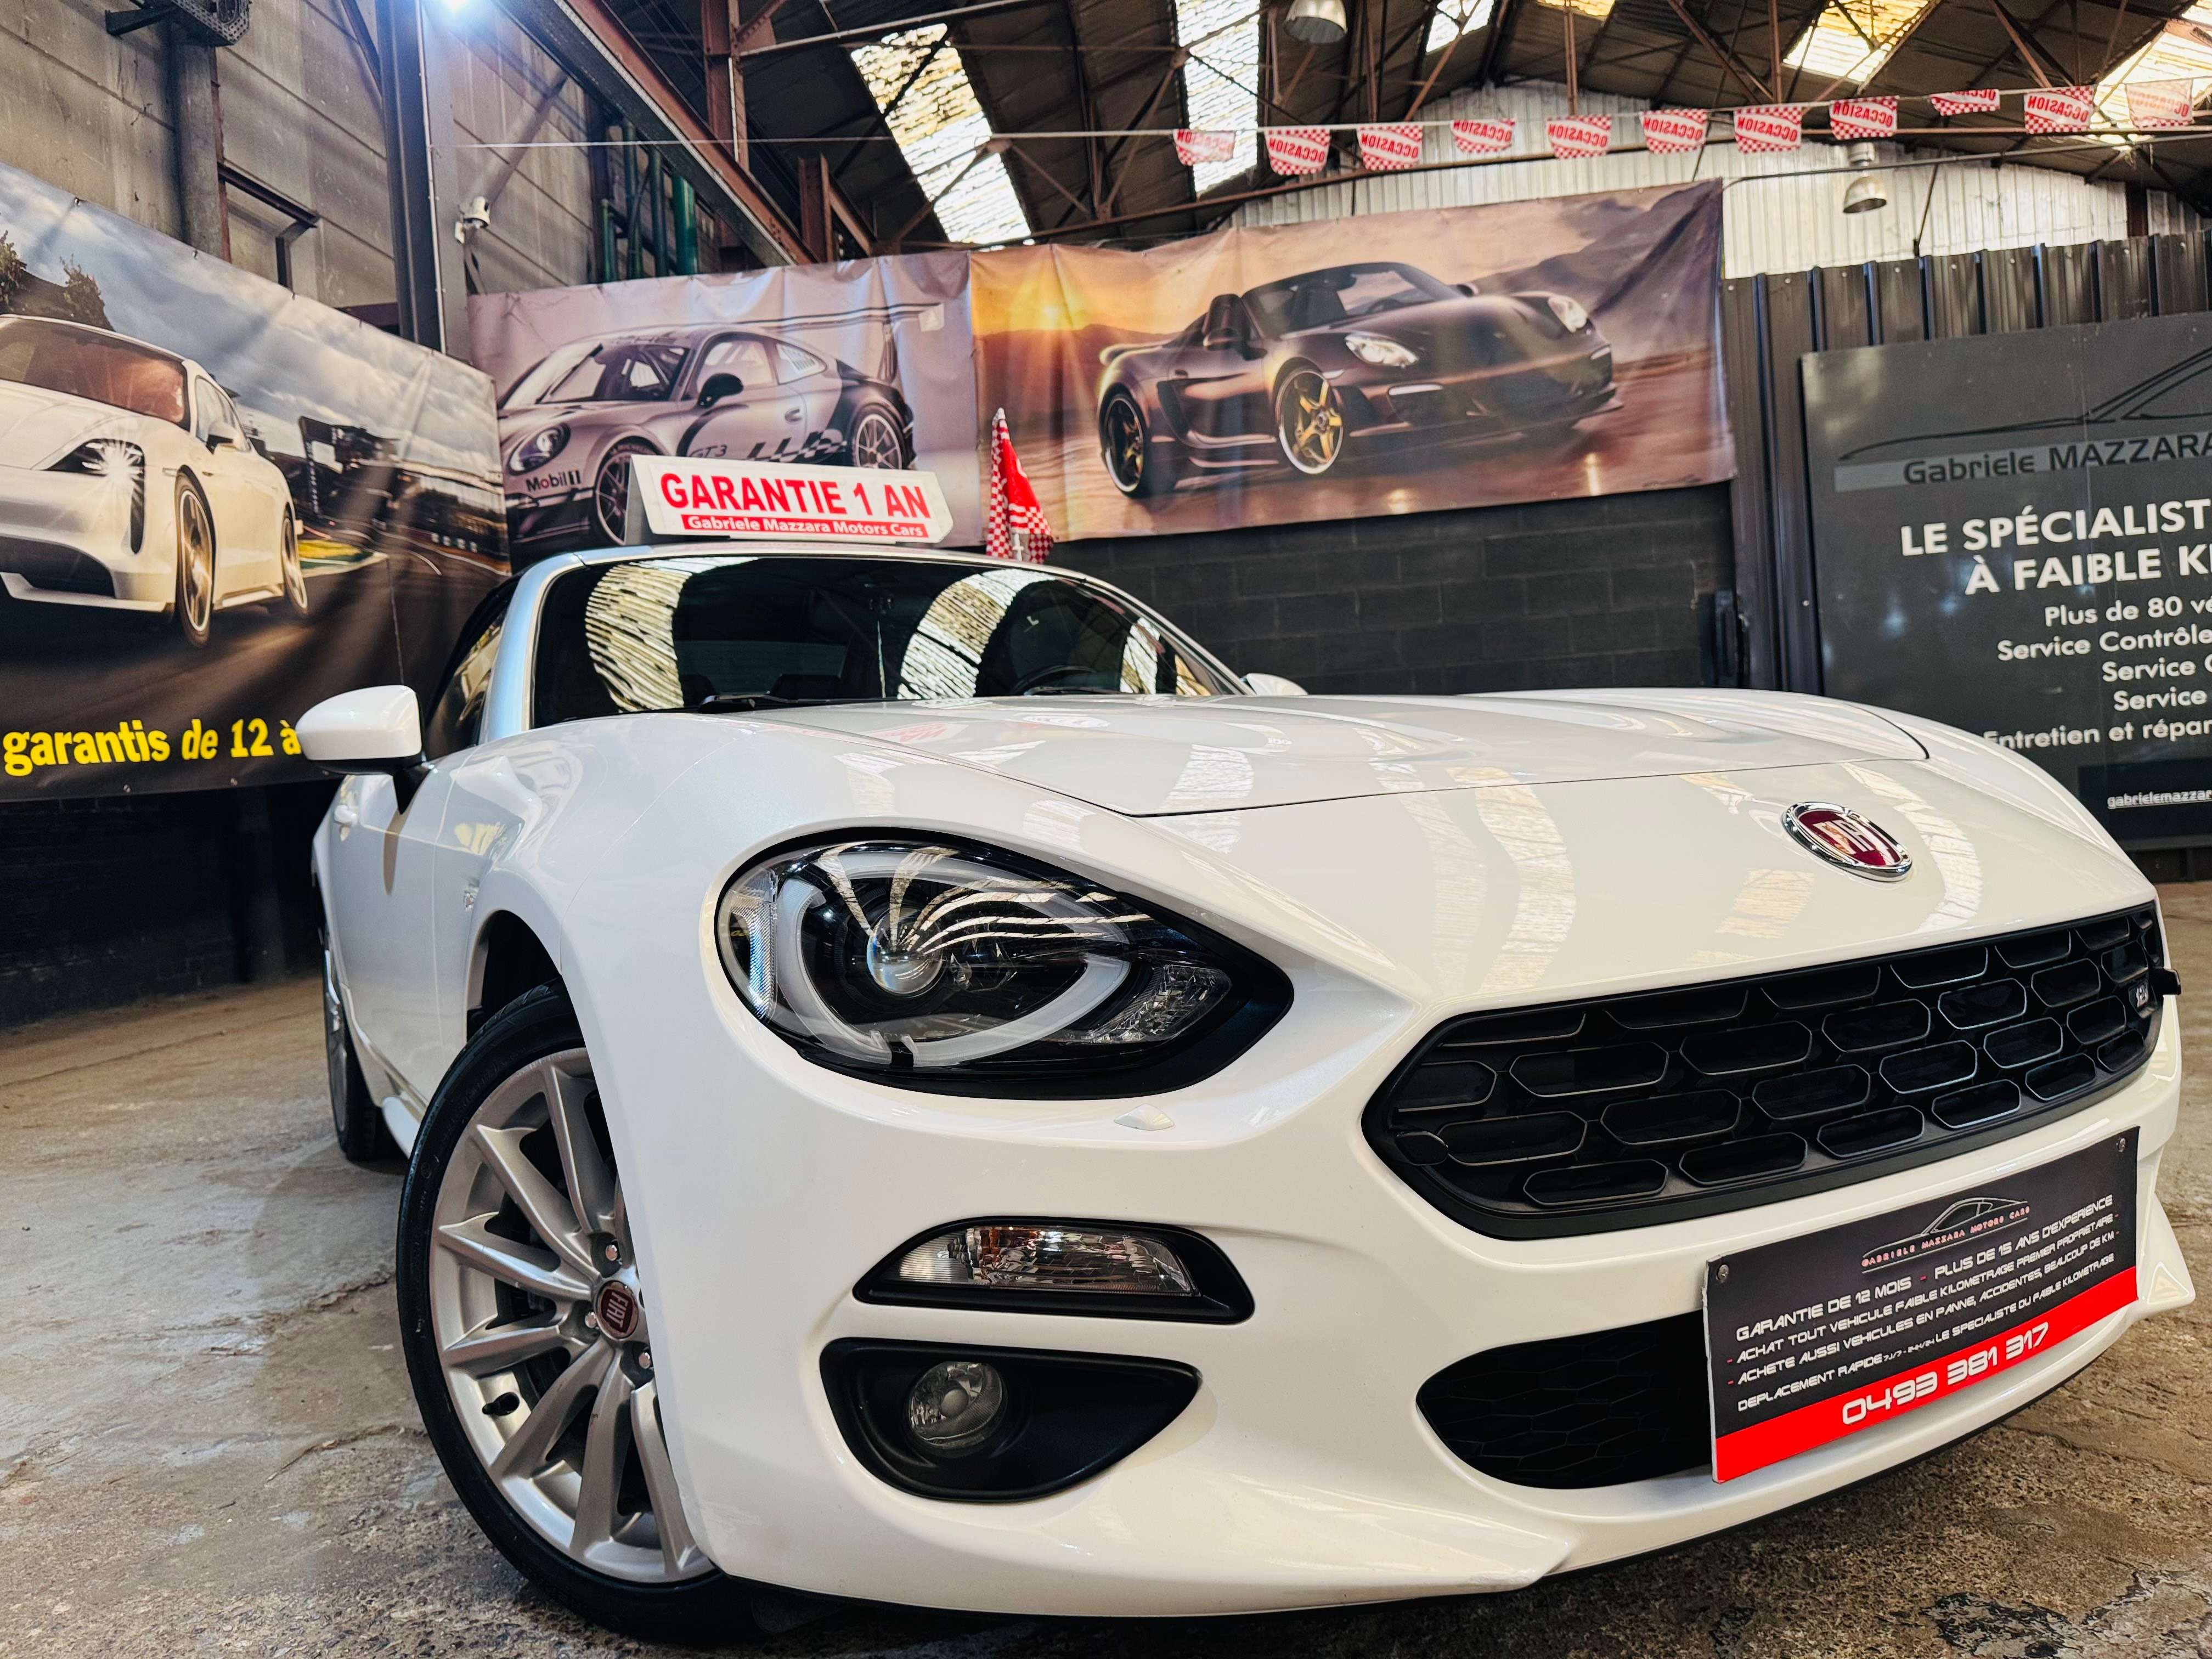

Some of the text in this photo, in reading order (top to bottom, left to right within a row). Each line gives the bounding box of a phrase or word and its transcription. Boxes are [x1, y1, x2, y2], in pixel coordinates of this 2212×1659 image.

[1904, 452, 2035, 484] Gabriele
[660, 473, 932, 519] GARANTIE 1 AN
[687, 515, 924, 537] Gabriele Mazzara Motors Cars
[1900, 498, 2211, 556] LE SPÉCIALIST
[1965, 543, 2212, 595] À FAIBLE K
[2045, 604, 2098, 627] Plus
[2106, 600, 2140, 622] de
[2147, 596, 2183, 618] 80
[1997, 623, 2212, 661] Service Contrôle
[2102, 657, 2196, 682] Service
[2113, 686, 2208, 712] Service
[3, 718, 301, 777] garantis de 12 à
[2108, 721, 2135, 742] et
[1736, 1194, 2113, 1341] GARANTIE DE 12 MOIS PLUS DE 15 ANS D'EXPERIENCE
[1737, 1214, 2113, 1363] ACHAT TOUT VEHICULE FAIBLE KILOMETRAGE PREMIER PROPRIETAIRE
[606, 1292, 629, 1328] FIAT
[1738, 1357, 1795, 1385] ACHETE
[1799, 1342, 1840, 1364] AUSSI
[1843, 1317, 1914, 1348] VEHICULES
[1916, 1312, 1933, 1325] EN
[1936, 1296, 1977, 1319] PANNE,
[2045, 1244, 2087, 1274] BEAUCOUP
[2090, 1237, 2101, 1251] DE
[2102, 1231, 2114, 1244] KM
[1738, 1369, 1835, 1412] DEPLACEMENT
[1838, 1353, 1883, 1377] RAPIDE
[1936, 1329, 1950, 1342] LE
[1952, 1300, 2017, 1336] SPECIALISTE
[2018, 1296, 2032, 1310] DU
[2063, 1253, 2114, 1287] KILOMETRAGE
[1842, 1322, 2049, 1425] 0493 381 317
